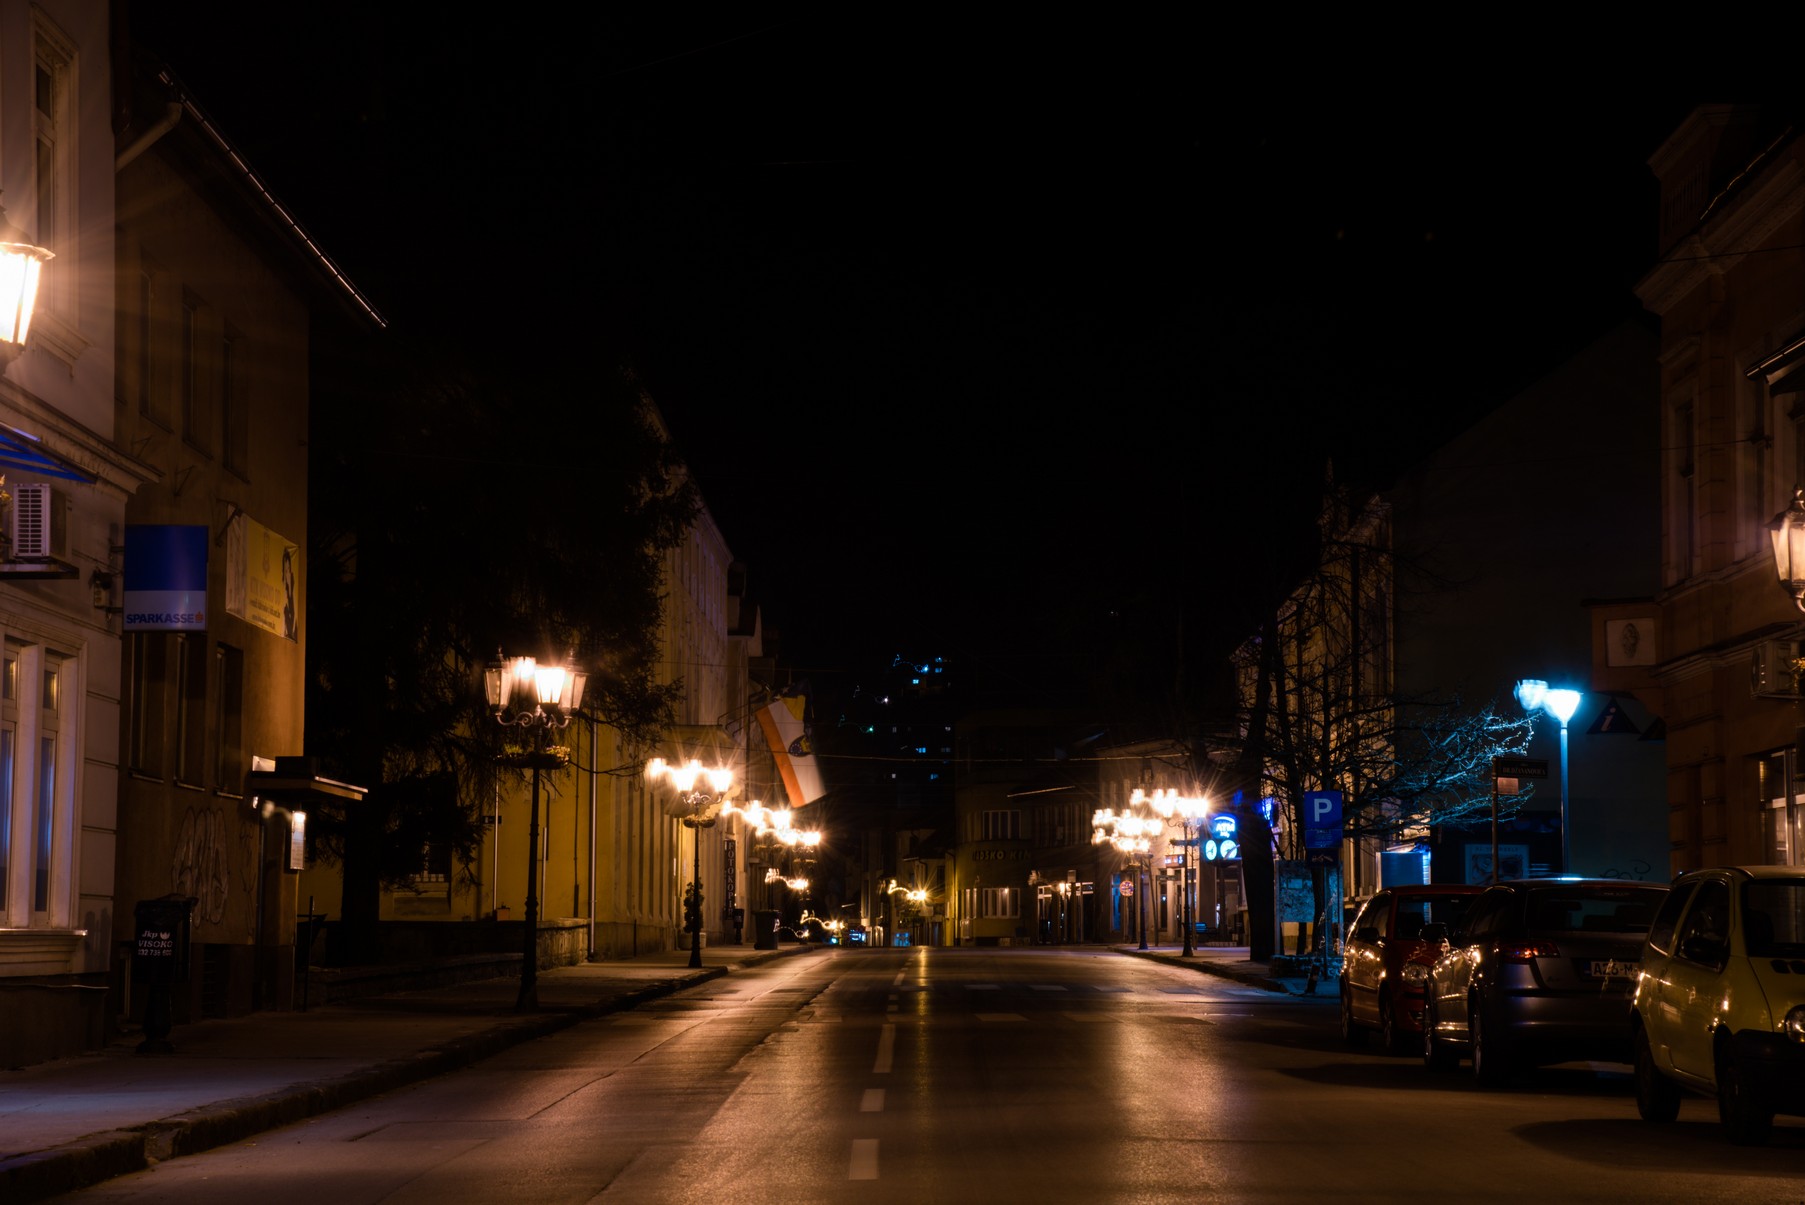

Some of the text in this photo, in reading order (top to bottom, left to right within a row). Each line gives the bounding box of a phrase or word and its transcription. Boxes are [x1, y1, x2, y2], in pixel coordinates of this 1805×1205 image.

[126, 613, 194, 624] SPARKASSE
[1313, 797, 1333, 823] P
[138, 940, 173, 949] VISOKO
